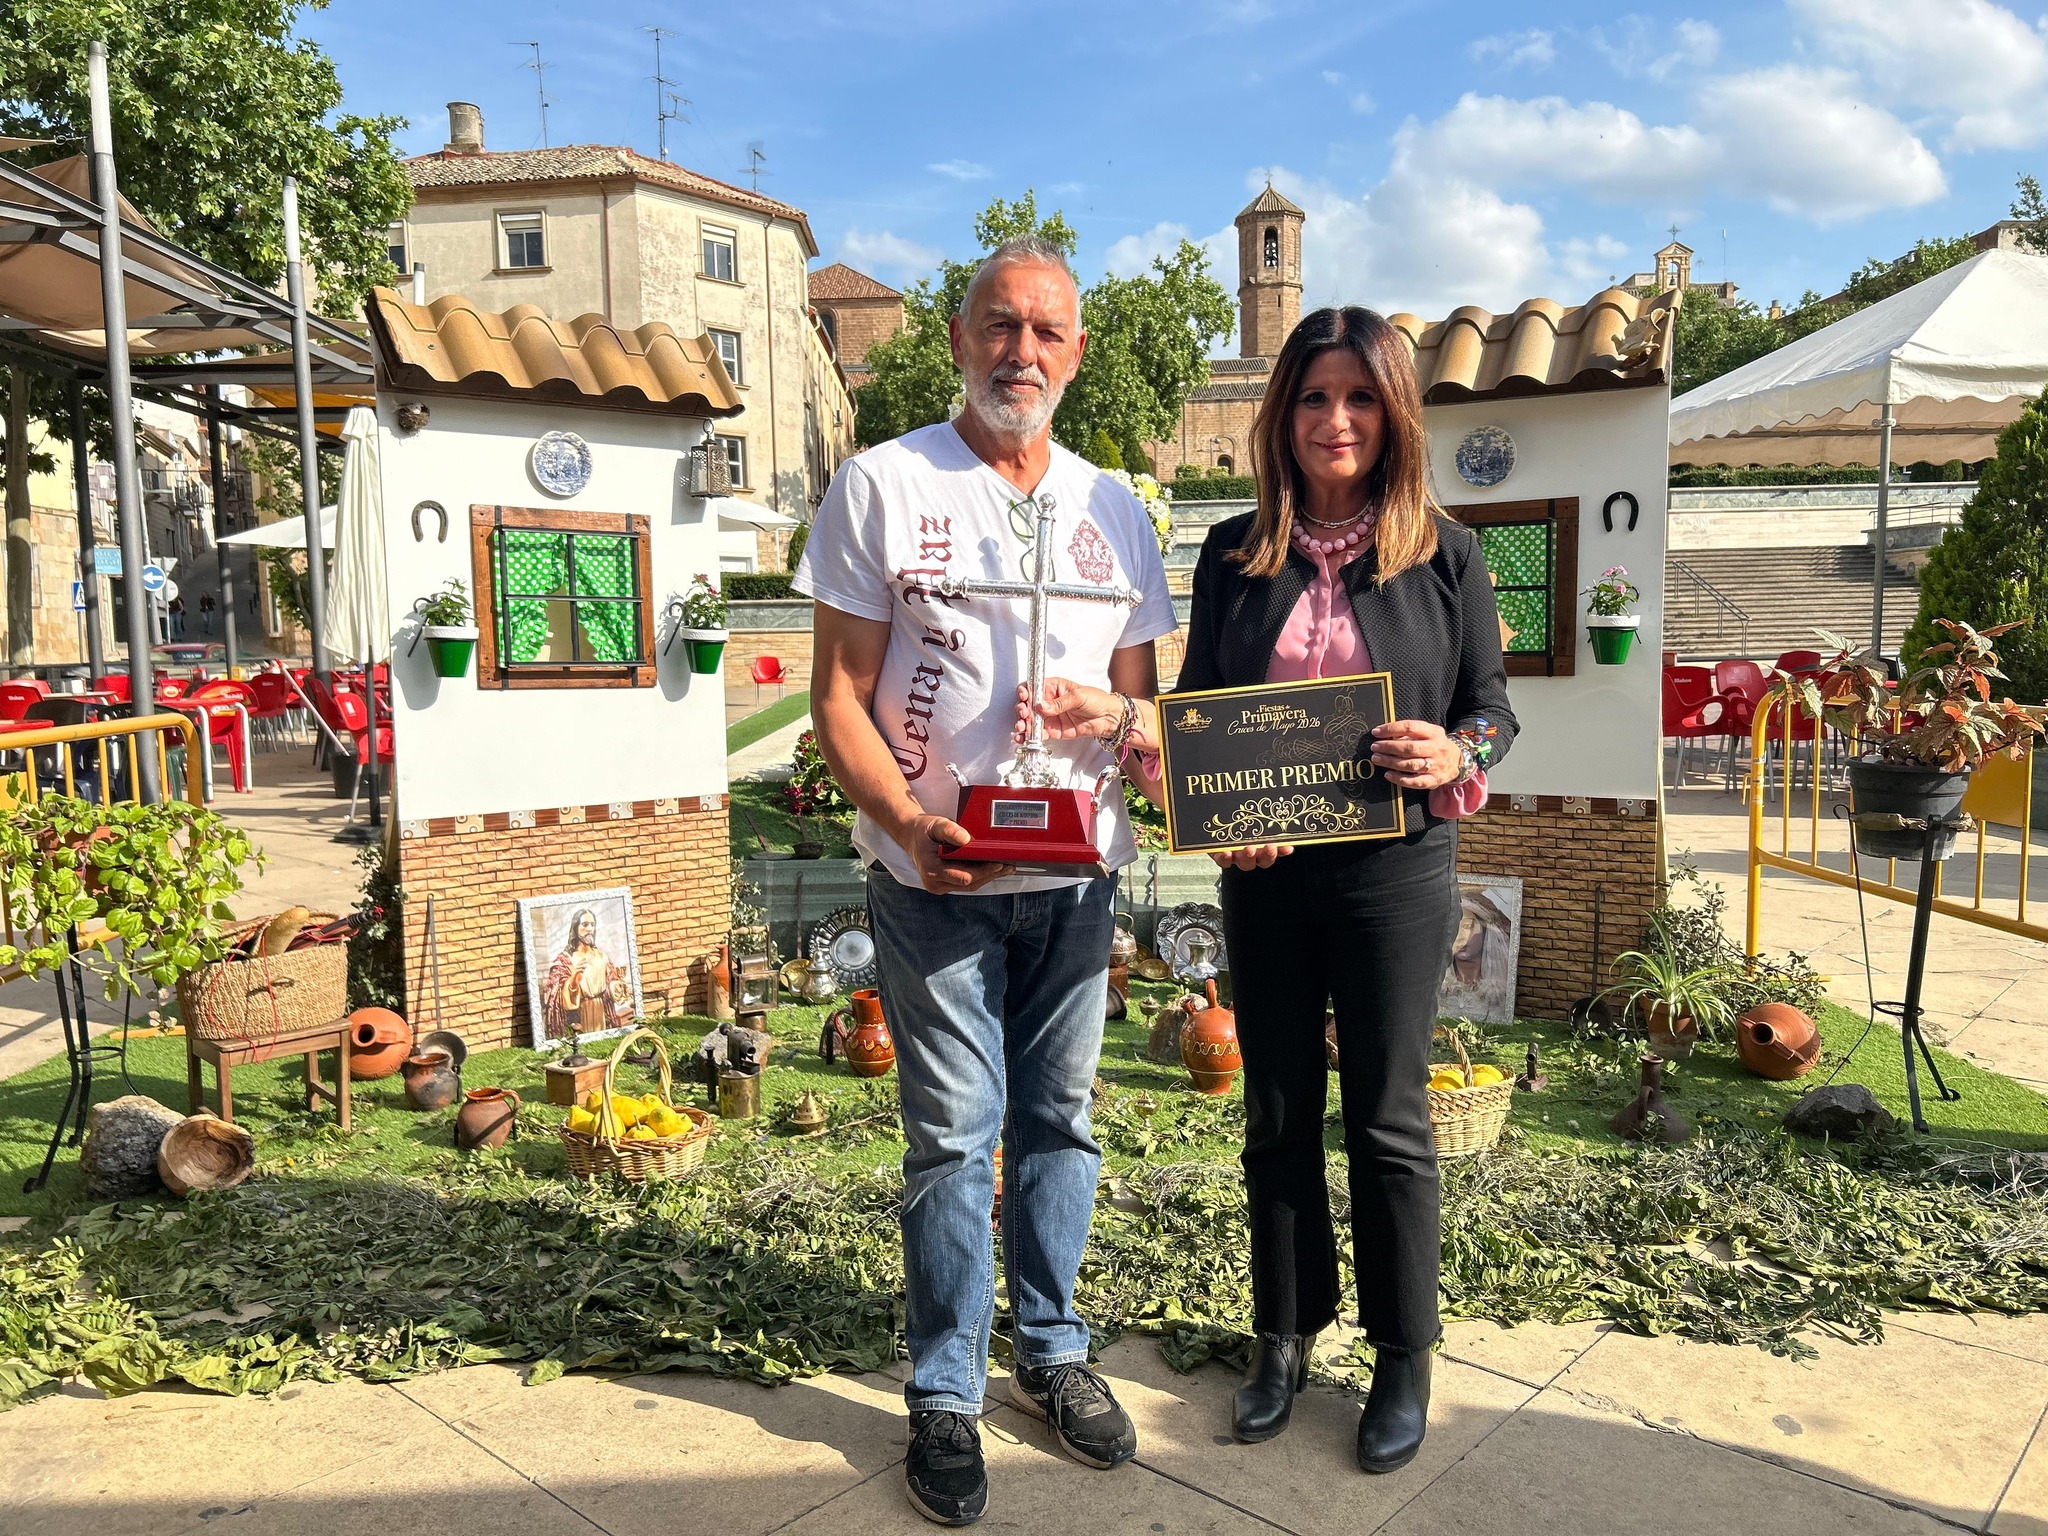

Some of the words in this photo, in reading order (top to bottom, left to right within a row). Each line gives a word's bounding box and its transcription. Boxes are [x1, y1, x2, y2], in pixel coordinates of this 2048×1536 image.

[896, 514, 970, 609] Paz
[921, 624, 966, 652] y
[885, 661, 944, 781] Cena
[1241, 708, 1308, 725] Primavera
[1259, 704, 1285, 713] Fiestas
[1227, 720, 1254, 736] Cruces
[1256, 721, 1267, 733] de
[1264, 719, 1296, 736] Mayo
[1296, 716, 1321, 730] 2026
[1185, 768, 1277, 796] PRIMER
[1279, 758, 1375, 787] PREMIO
